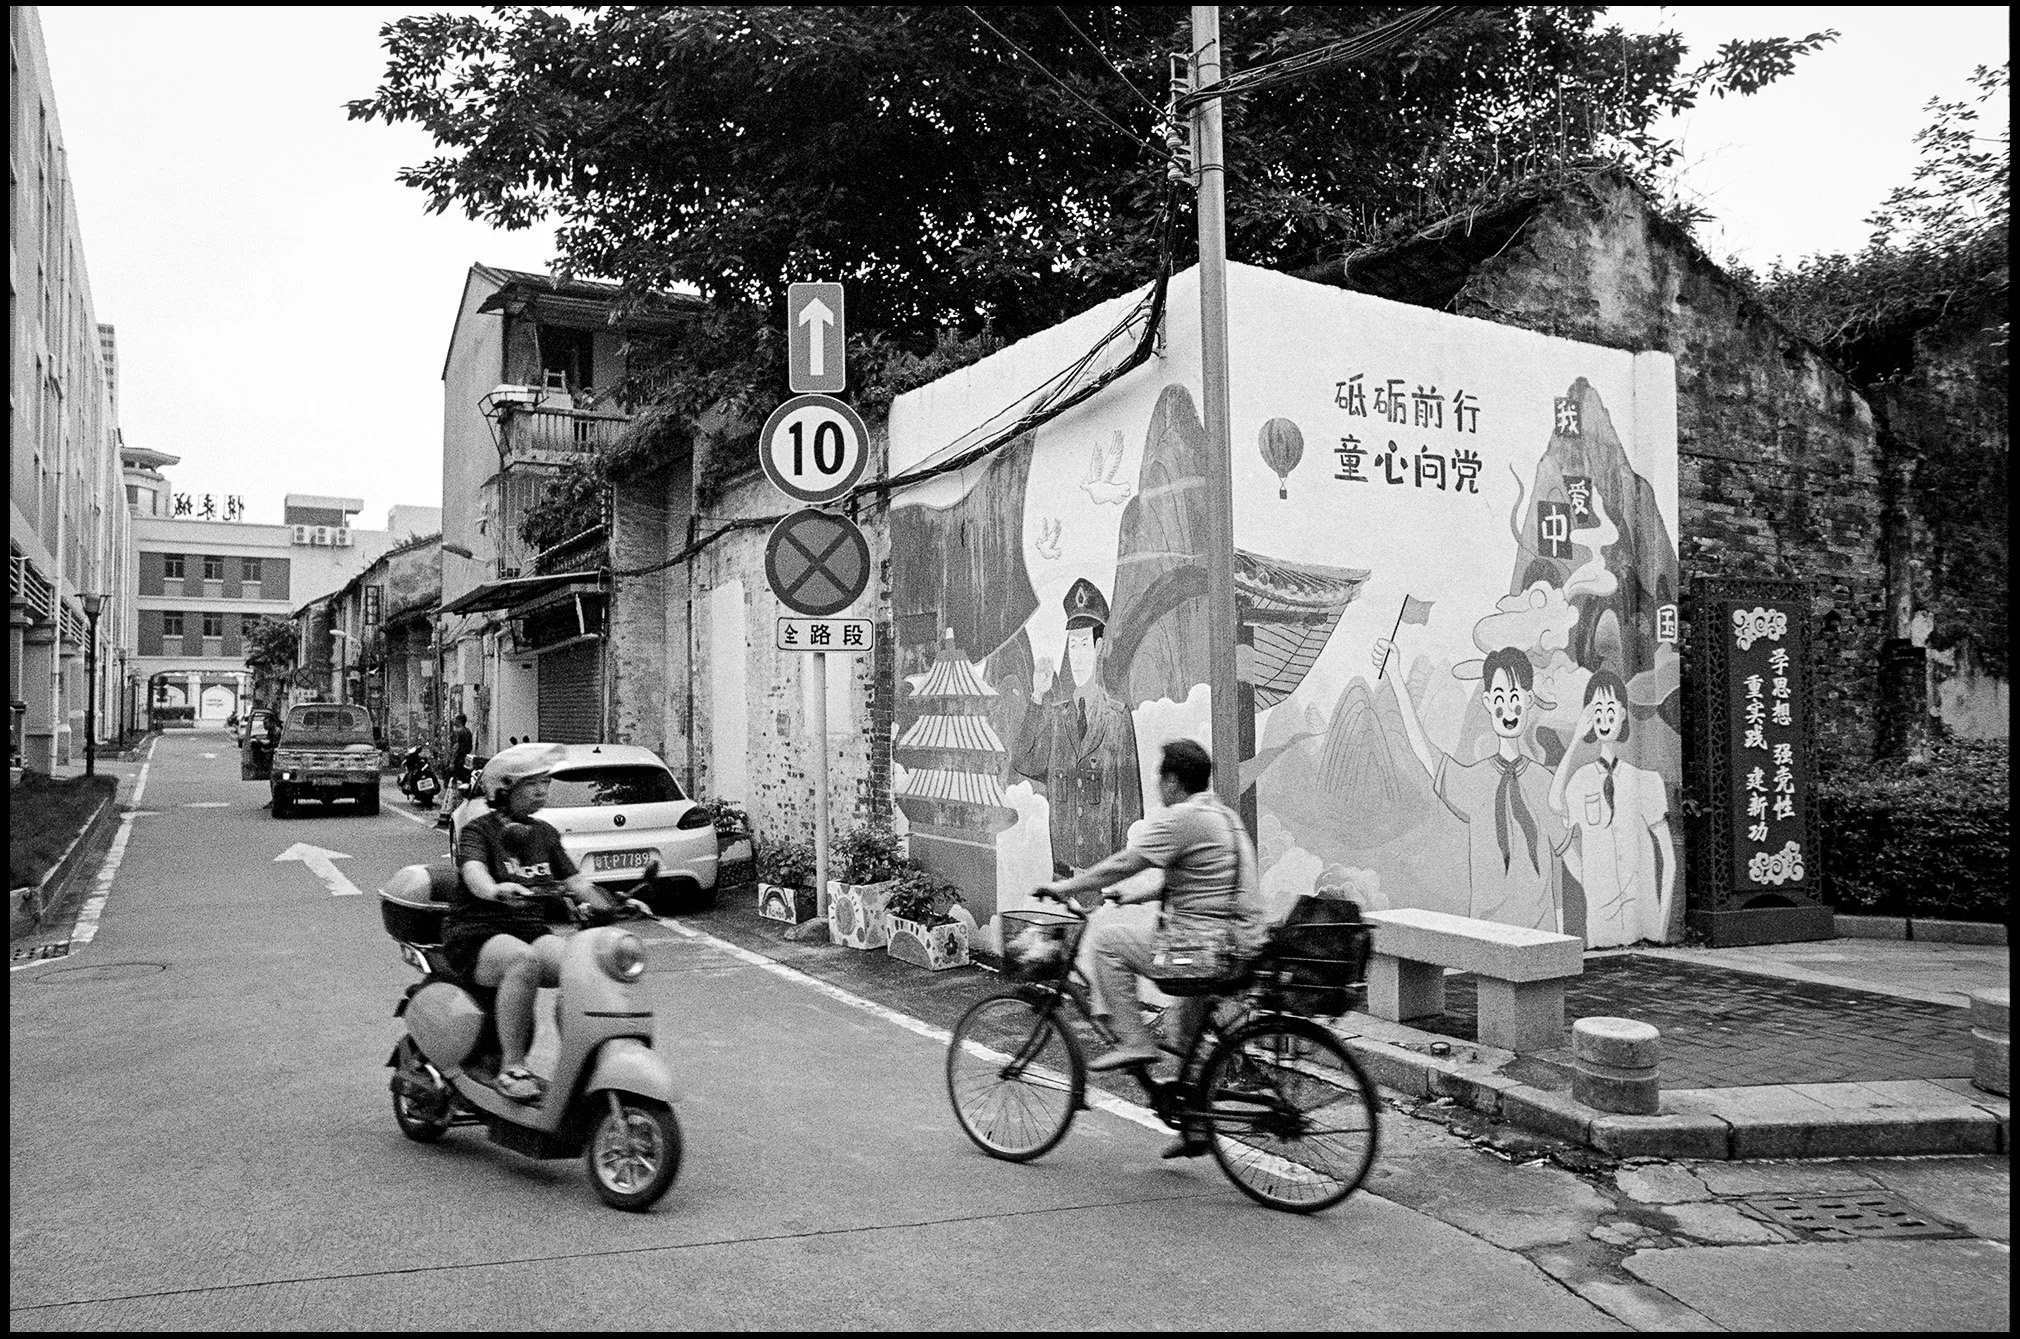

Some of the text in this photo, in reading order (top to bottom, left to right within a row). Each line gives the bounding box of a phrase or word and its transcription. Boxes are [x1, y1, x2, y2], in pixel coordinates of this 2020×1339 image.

[1335, 373, 1480, 433] 砥砺前行
[789, 421, 844, 475] 10
[1334, 434, 1482, 493] 童心向党
[1542, 399, 1678, 643] 我 爱 中 国
[784, 624, 863, 646] 全路段
[1744, 675, 1768, 842] 重实践 建新功
[1769, 648, 1795, 821] 学思想 强党性
